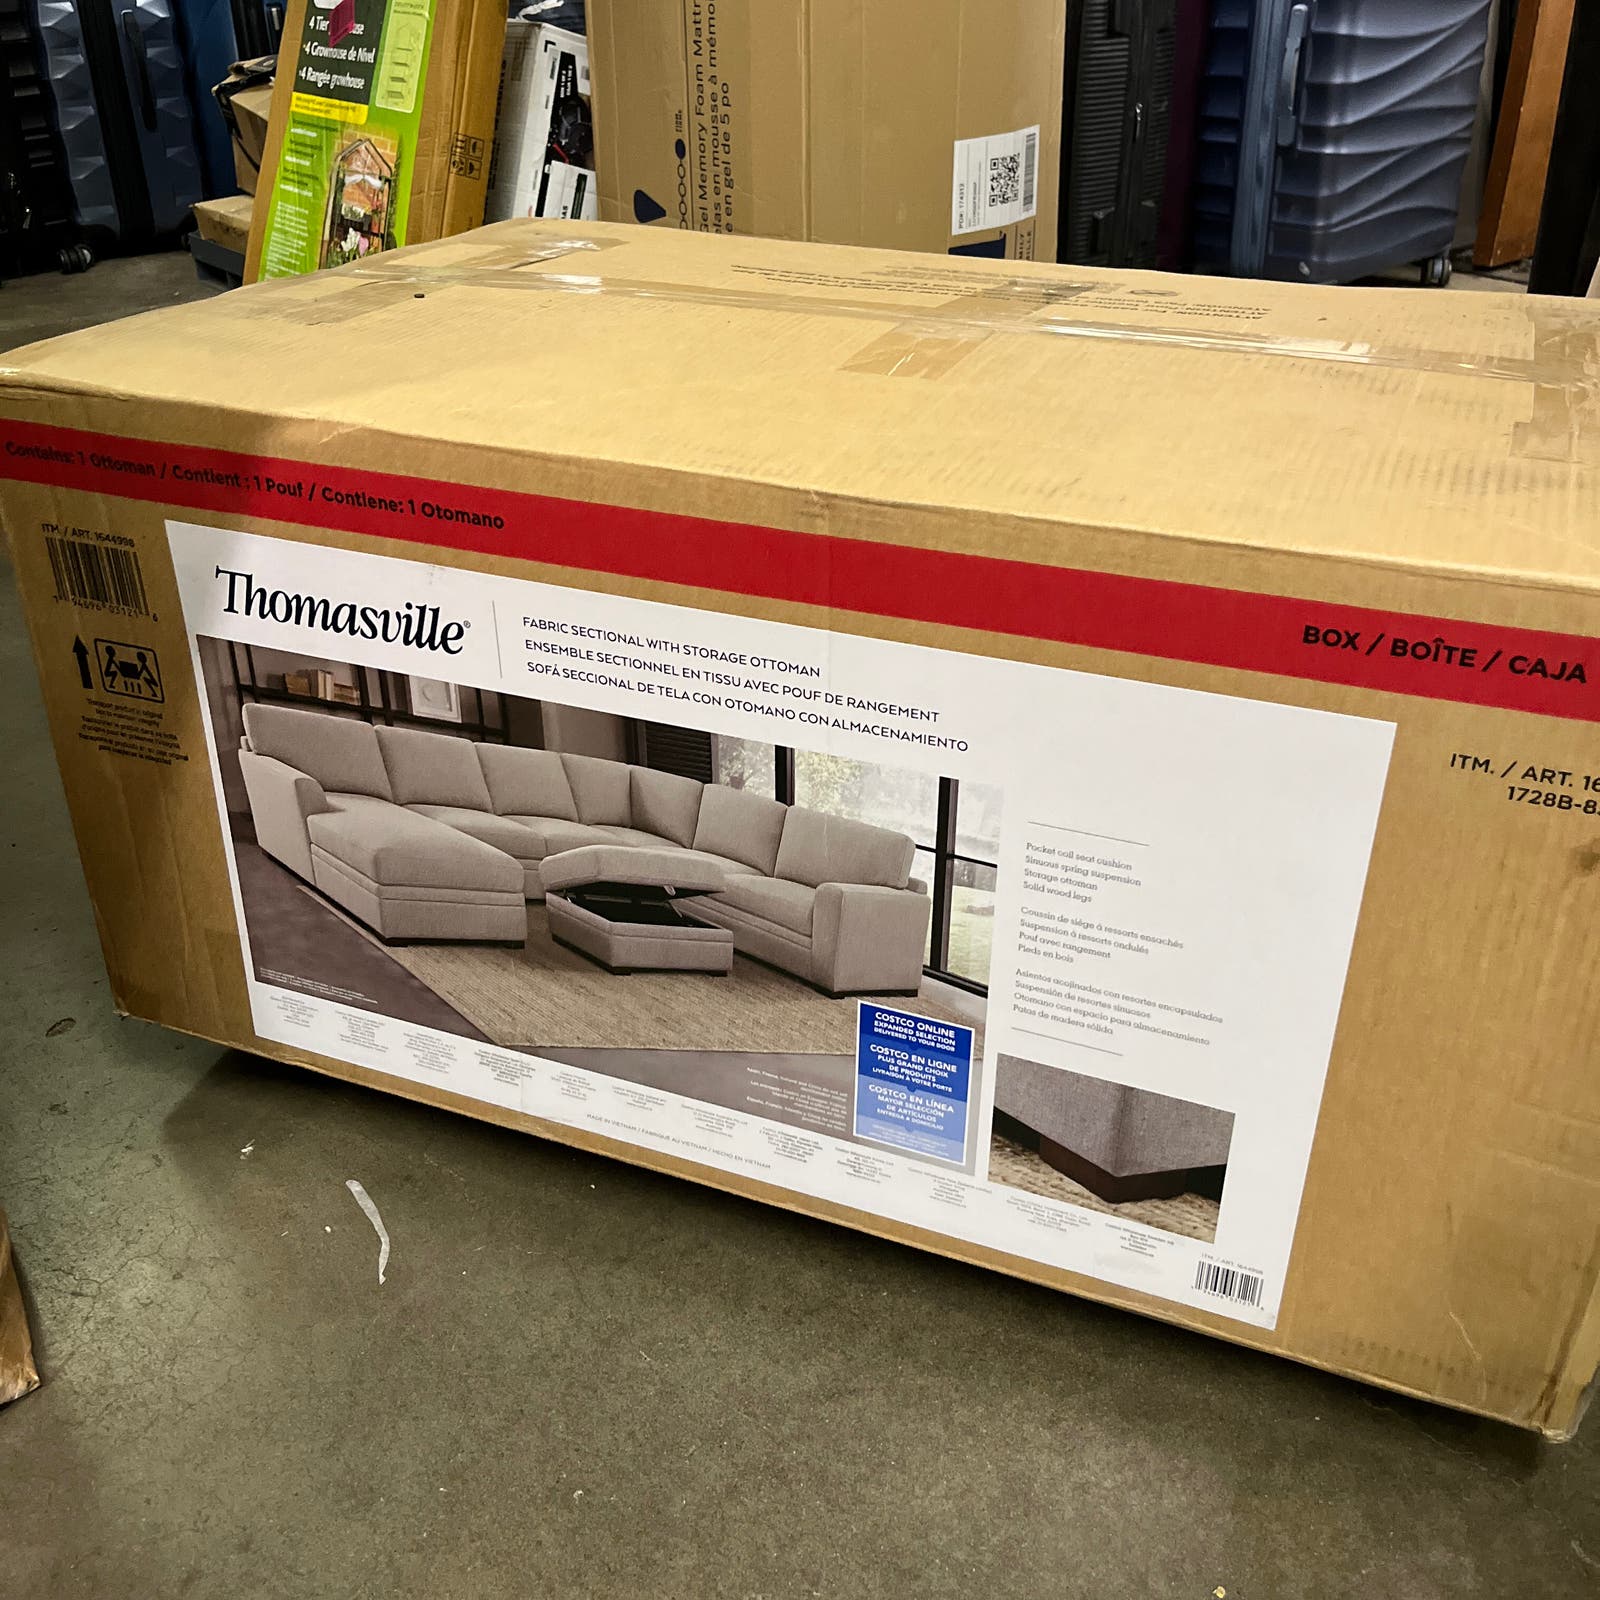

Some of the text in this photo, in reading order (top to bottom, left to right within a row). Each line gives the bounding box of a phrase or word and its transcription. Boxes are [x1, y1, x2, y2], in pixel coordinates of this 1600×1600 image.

[348, 46, 356, 61] de
[356, 48, 376, 64] Nivel
[330, 72, 365, 90] growhouse
[695, 64, 704, 116] Foam
[722, 83, 732, 107] po
[720, 114, 730, 125] 5
[708, 75, 720, 196] en mousse à
[721, 132, 730, 154] de
[698, 122, 708, 200] Memory
[722, 161, 734, 189] gel
[724, 194, 732, 216] en
[5, 441, 75, 464] Contains:
[78, 451, 85, 466] 1
[90, 454, 156, 477] Ottoman
[160, 462, 166, 480] /
[252, 476, 261, 491] 1
[264, 478, 304, 498] Pouf
[308, 483, 316, 502] /
[322, 487, 404, 514] Contiene:
[408, 500, 416, 515] 1
[421, 502, 505, 530] Otomano
[522, 616, 820, 678] FABRIC SECTIONAL WITH STORAGE OTTOMAN
[1302, 624, 1587, 684] BOX / BOÎTE / CAJA
[525, 639, 940, 722] ENSEMBLE SECTIONNEL EN TISSU AVEC POUF DE RANGEMENT
[527, 661, 969, 752] SOFÁ SECCIONAL DE TELA CON OTOMANO CON ALMACENAMIENTO
[1450, 752, 1495, 775] ITM.
[1500, 761, 1518, 778] /
[1520, 766, 1574, 788] ART.
[1508, 786, 1600, 816] 1728B-8
[1026, 842, 1132, 870] Pocket coil seat cushion
[1024, 868, 1098, 891] Storage ottoman
[1025, 856, 1142, 886] Sinuous spring suspension
[1023, 880, 1092, 903] Solid wood legs
[1020, 906, 1056, 922] Coussin
[1057, 914, 1070, 924] de
[1104, 926, 1139, 940] ressorts
[1140, 933, 1184, 950] ensachés
[1020, 918, 1070, 938] Suspension
[1078, 932, 1112, 946] ressorts
[1113, 940, 1150, 956] ondulés
[1018, 931, 1112, 960] Pouf avec rangement
[1018, 944, 1074, 964] Pieds en bois
[1015, 980, 1151, 1020] Suspensión de resortes sinuosos
[1016, 968, 1224, 1024] Asientos acojinados con resortes encapsulados
[875, 1012, 956, 1038] COSTCO ONLINE
[1013, 1004, 1114, 1035] Patas de madera sólida
[1014, 992, 1210, 1045] Otomano con espacio para almacenamiento
[874, 1020, 956, 1046] EXPANDED SELECTION
[874, 1026, 956, 1052] DELIVERED TO YOUR DOOR
[870, 1044, 958, 1072] COSTCO EN LIGNE
[878, 1055, 949, 1078] PLUS GRAND CHOIX
[872, 1068, 952, 1093] LIVRAISON VOTRE PORTE
[888, 1064, 936, 1082] DE PRODUITS
[868, 1084, 954, 1114] COSTCO EN LÍNEA
[878, 1094, 944, 1118] MAYOR SELECCIÓN
[876, 1108, 904, 1120] ENTREGA
[886, 1104, 937, 1123] DE ARTÍCULOS
[586, 1114, 602, 1122] MADE
[612, 1120, 637, 1131] VIETNAM
[682, 1140, 708, 1152] VIETNAM
[712, 1148, 734, 1160] HECHO
[734, 1154, 744, 1162] EN
[744, 1156, 772, 1169] VIETNAM
